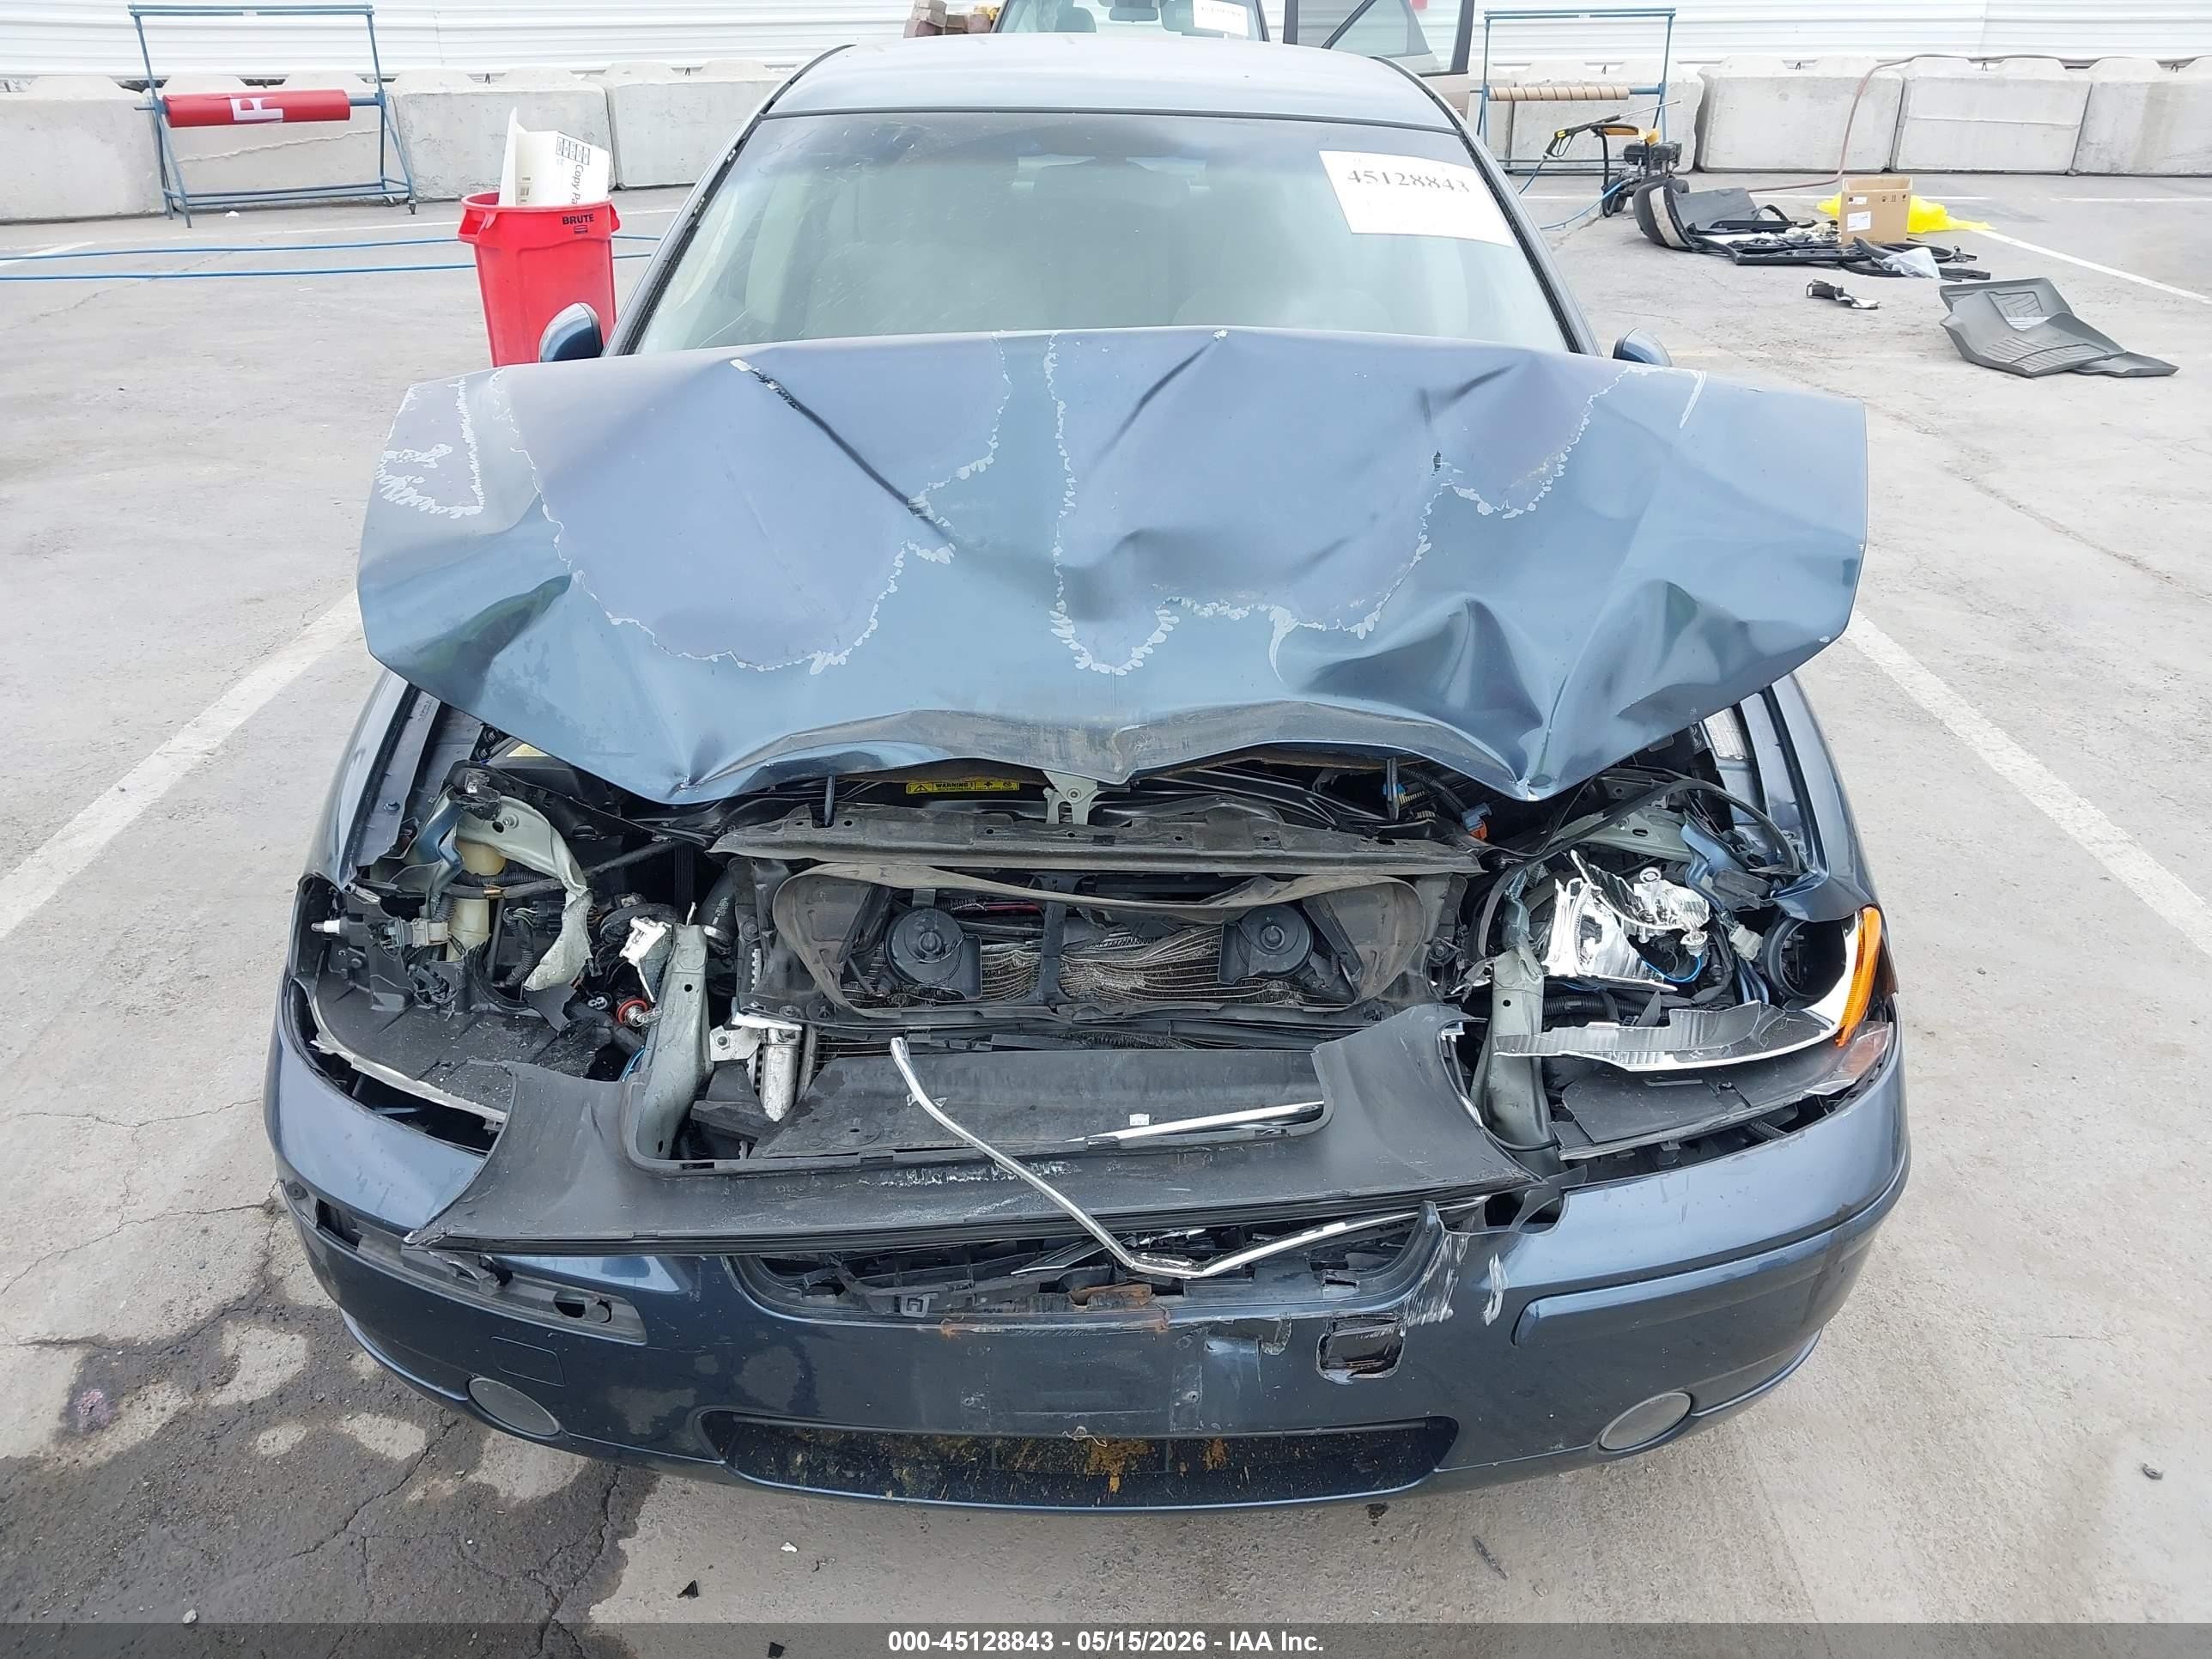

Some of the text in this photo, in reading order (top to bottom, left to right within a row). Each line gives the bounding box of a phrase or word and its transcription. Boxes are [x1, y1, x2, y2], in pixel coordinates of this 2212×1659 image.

[571, 164, 584, 191] Copy
[1347, 170, 1470, 192] 45128843
[562, 213, 594, 225] BRUTE
